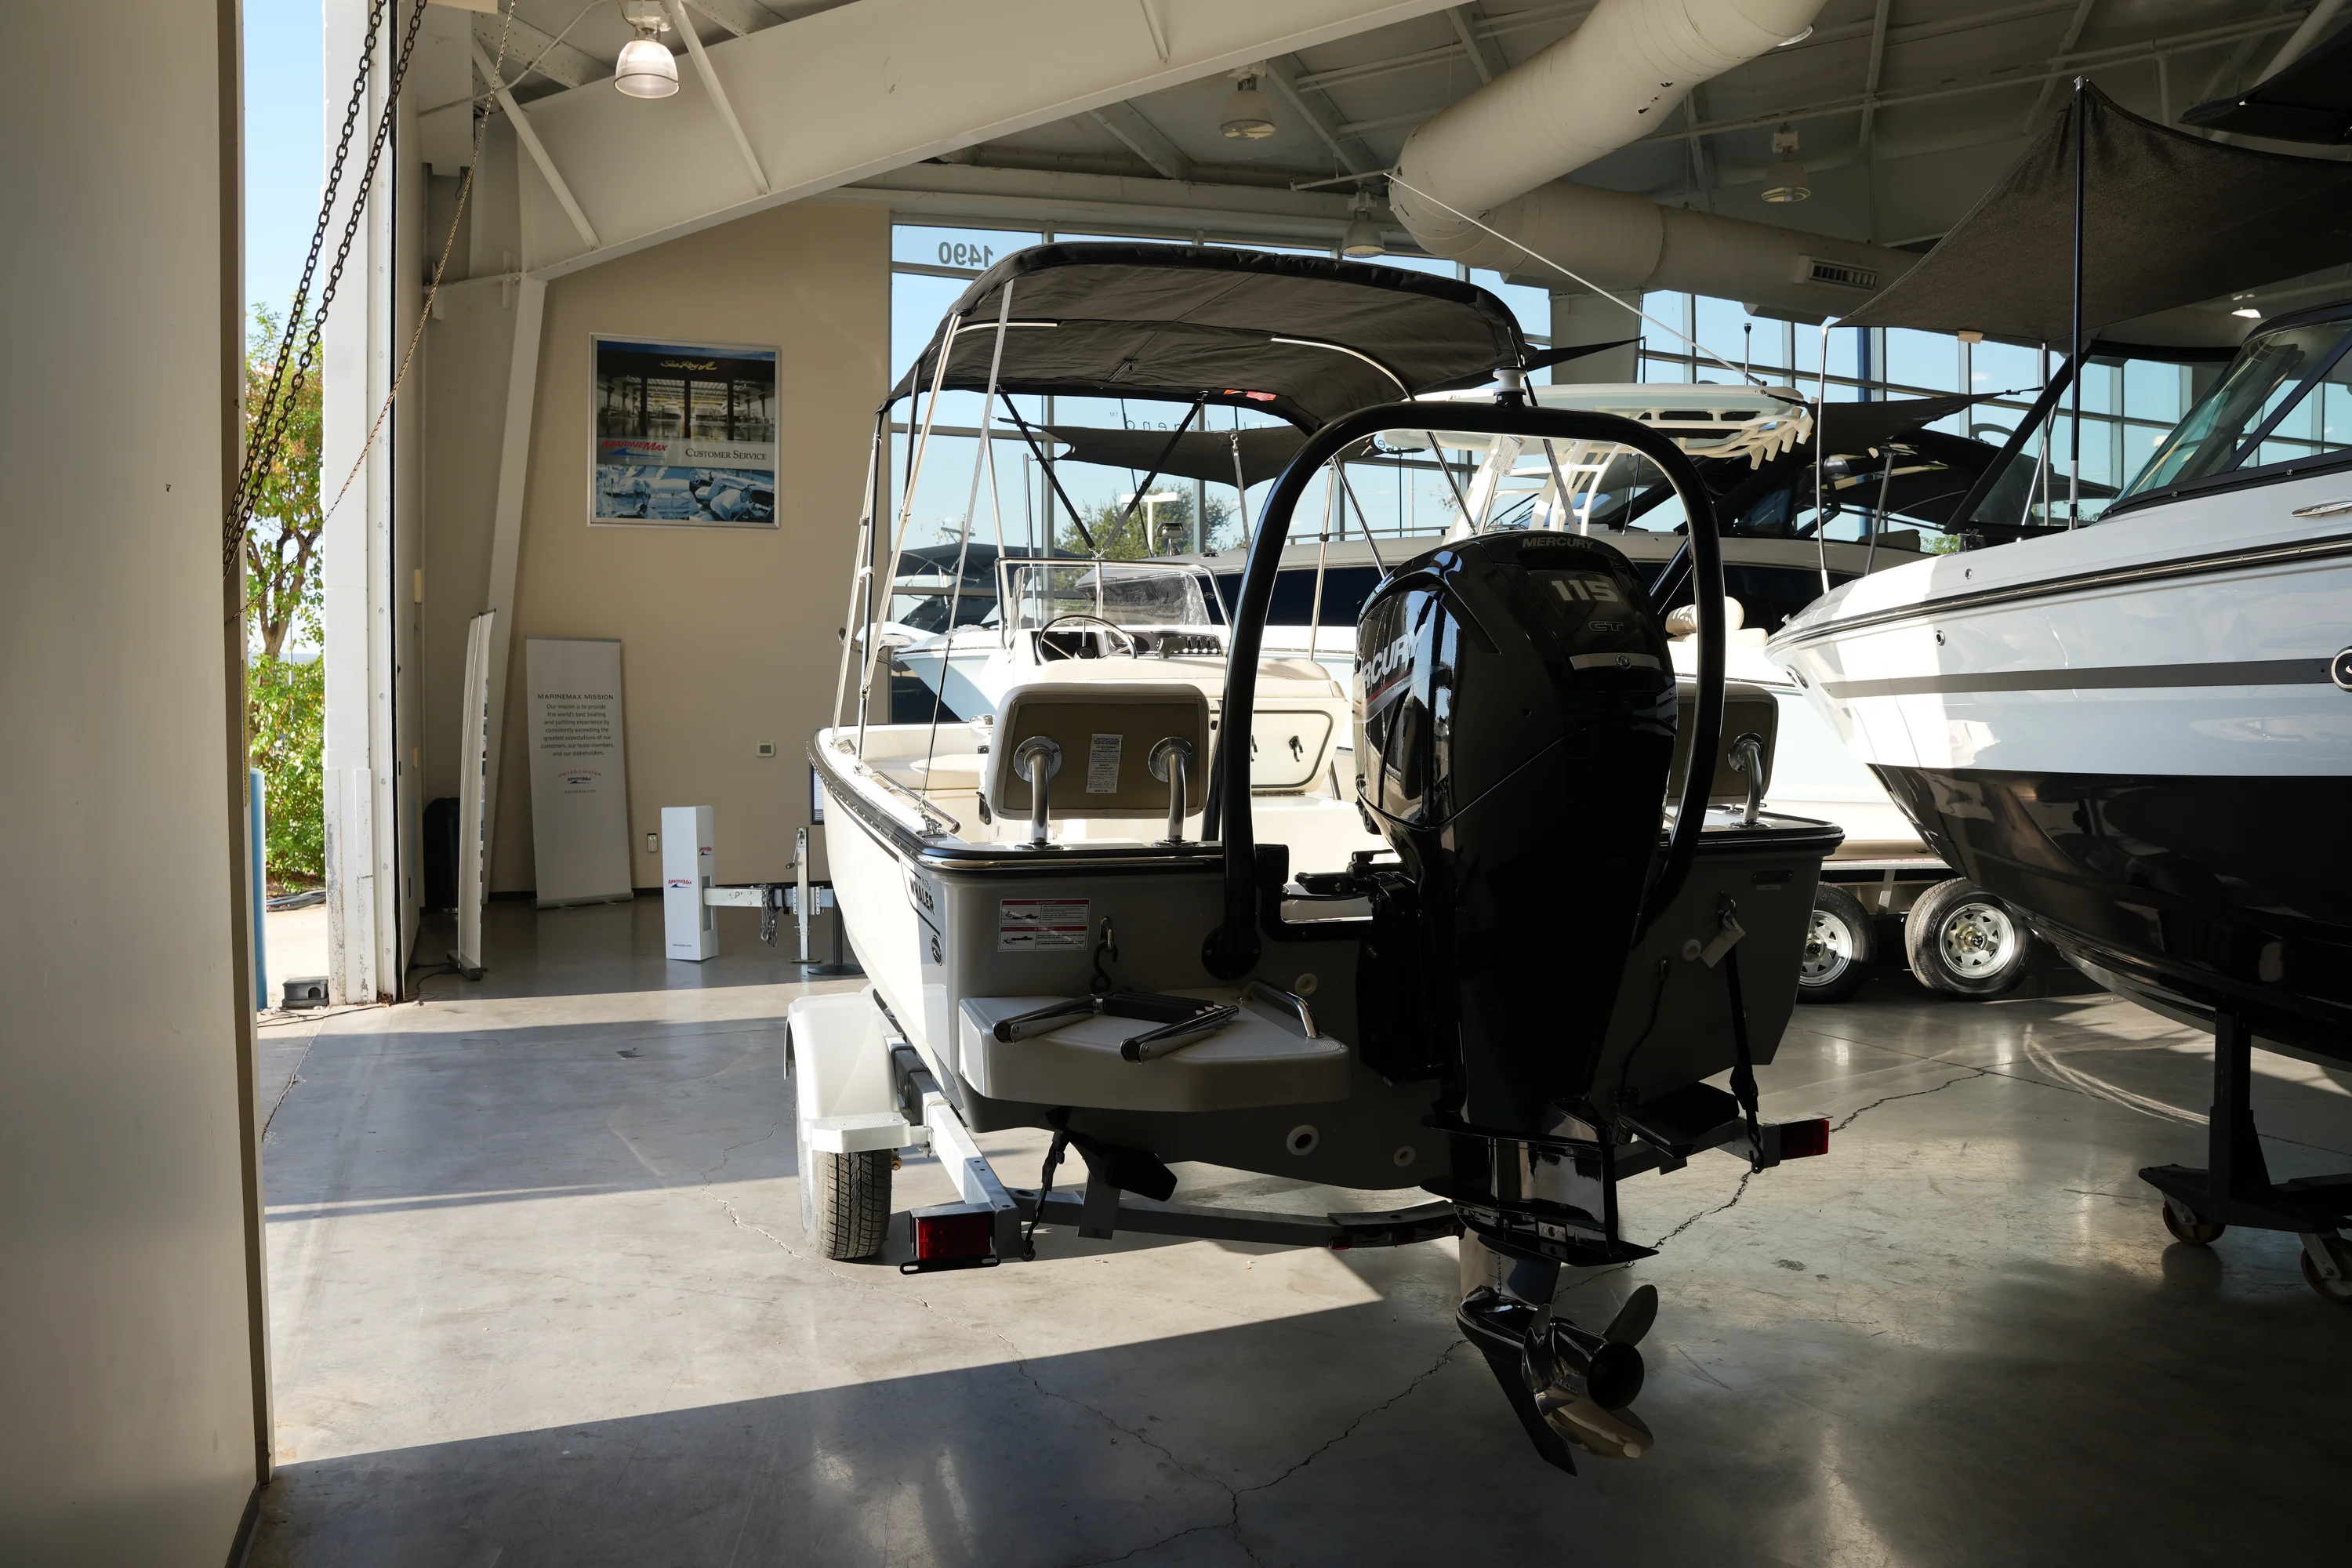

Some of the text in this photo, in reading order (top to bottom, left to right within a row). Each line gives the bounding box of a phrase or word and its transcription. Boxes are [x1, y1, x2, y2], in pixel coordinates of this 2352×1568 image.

[1523, 536, 1595, 550] MERCURY
[1551, 579, 1619, 603] 115
[1588, 620, 1624, 632] CT
[909, 877, 935, 916] WHALER
